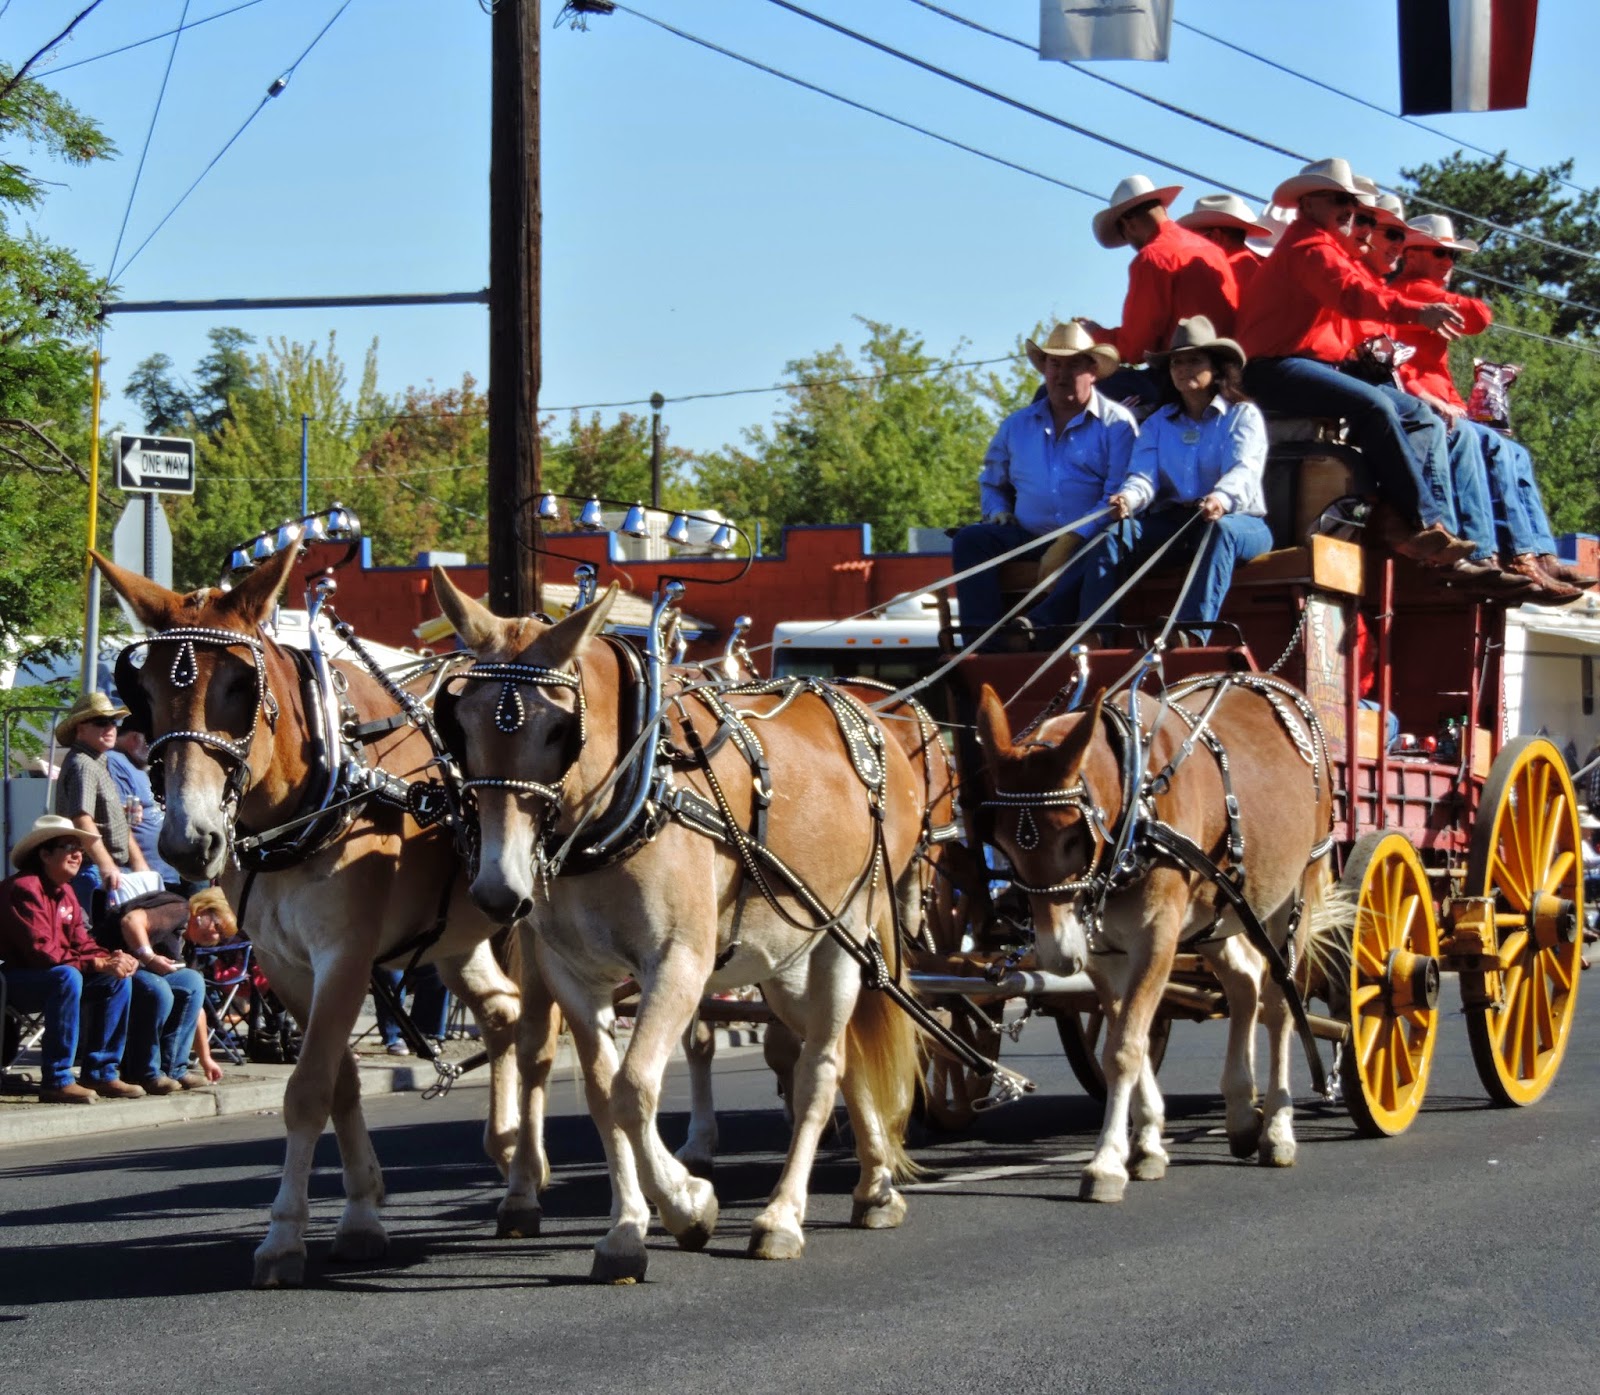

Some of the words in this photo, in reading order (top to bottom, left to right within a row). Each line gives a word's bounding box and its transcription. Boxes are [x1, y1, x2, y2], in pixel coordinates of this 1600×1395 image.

[141, 453, 161, 474] ONE
[165, 455, 186, 476] WAY
[418, 795, 433, 812] L
